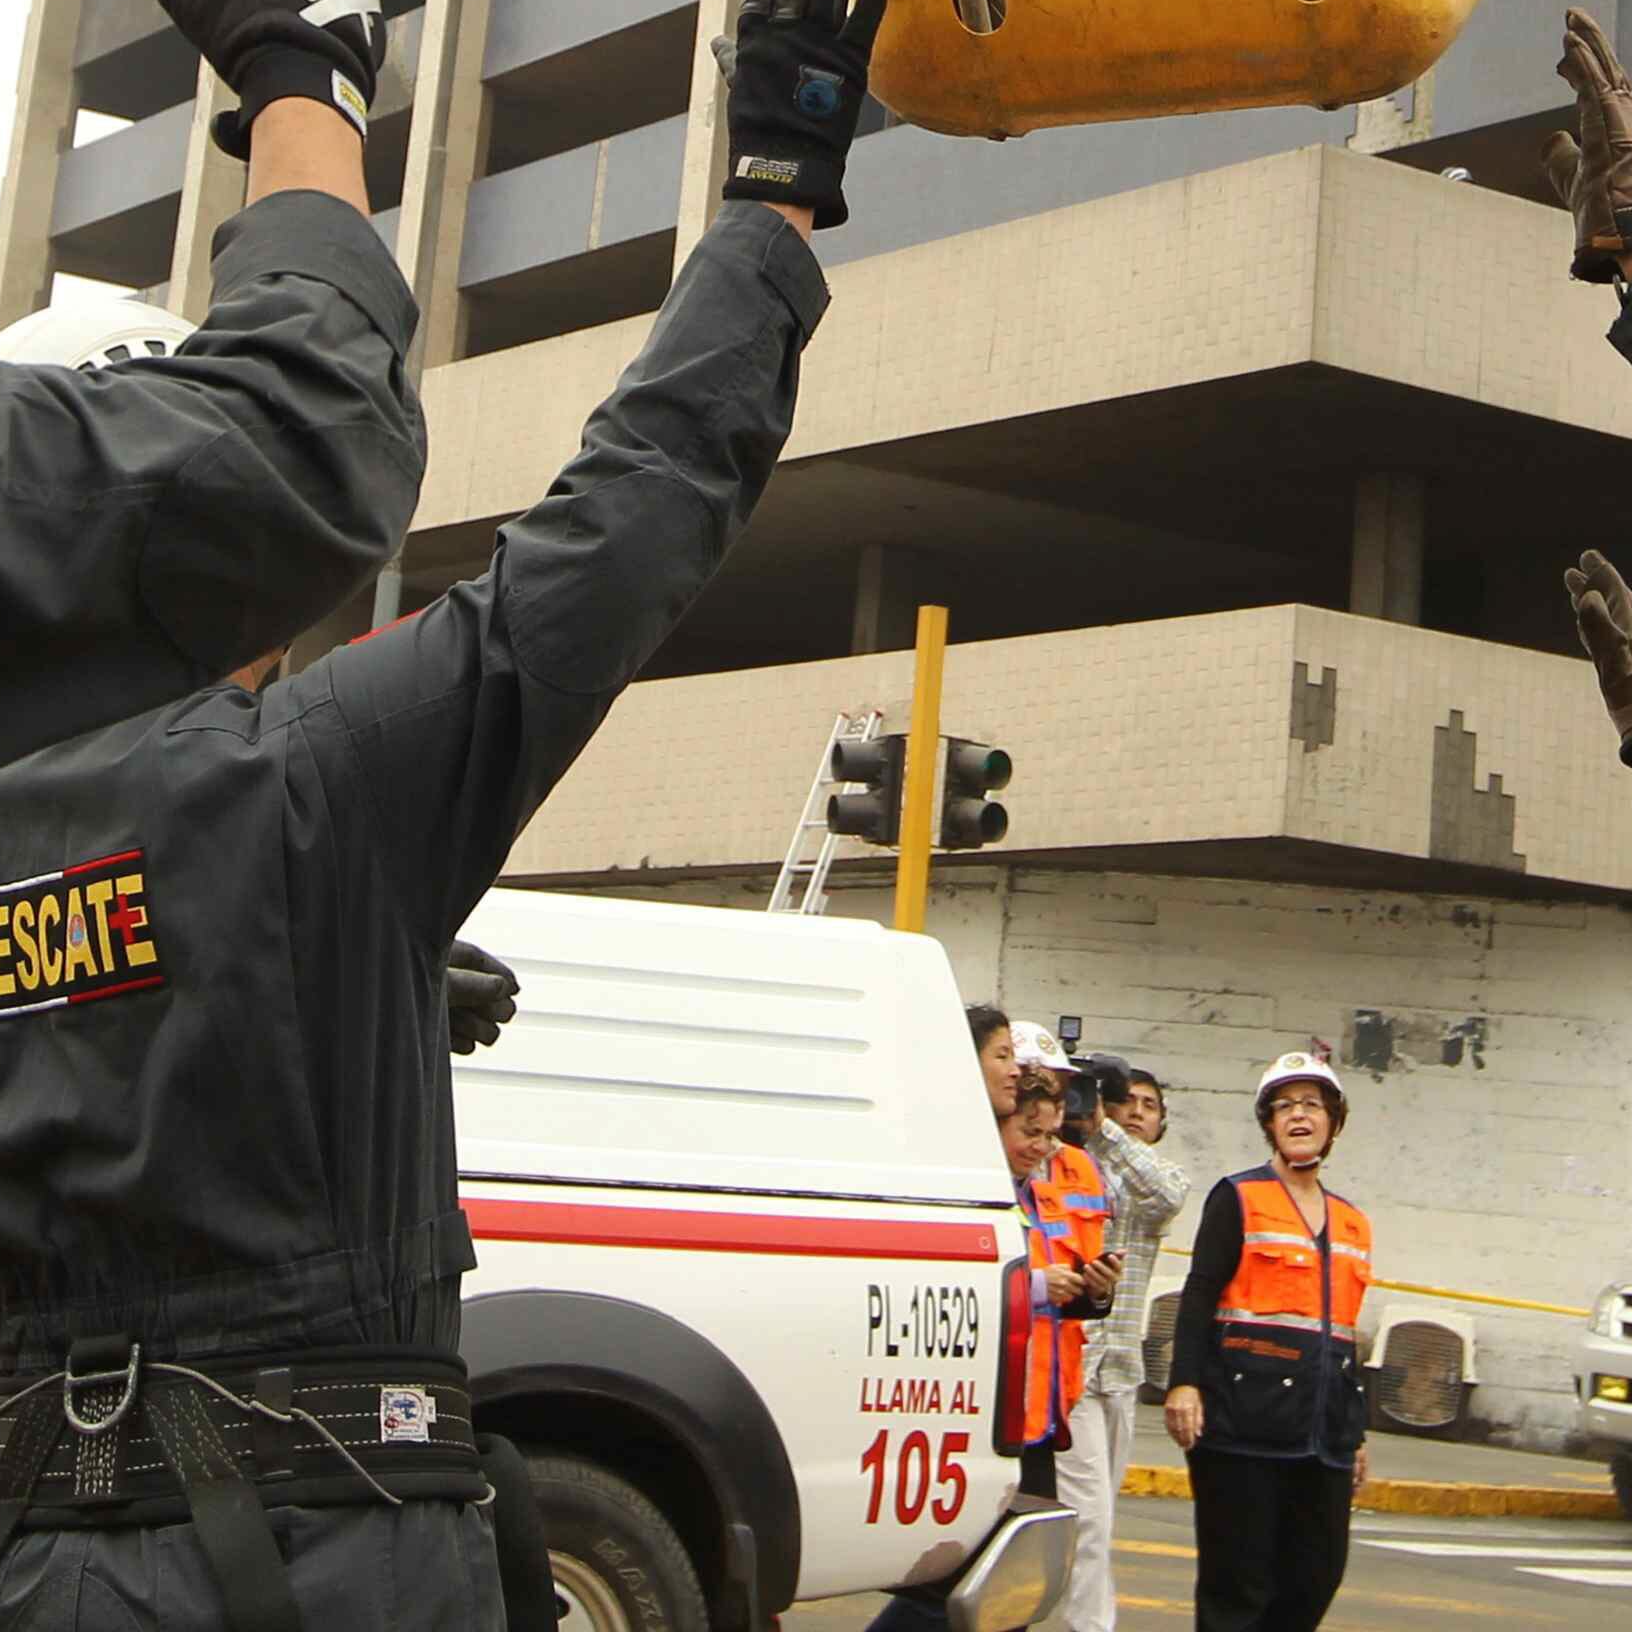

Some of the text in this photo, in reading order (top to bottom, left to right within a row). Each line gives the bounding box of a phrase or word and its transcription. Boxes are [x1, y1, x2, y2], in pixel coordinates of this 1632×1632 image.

[867, 1284, 980, 1359] PL-10529
[861, 1377, 981, 1415] LLAMA AL
[860, 1429, 971, 1525] 105
